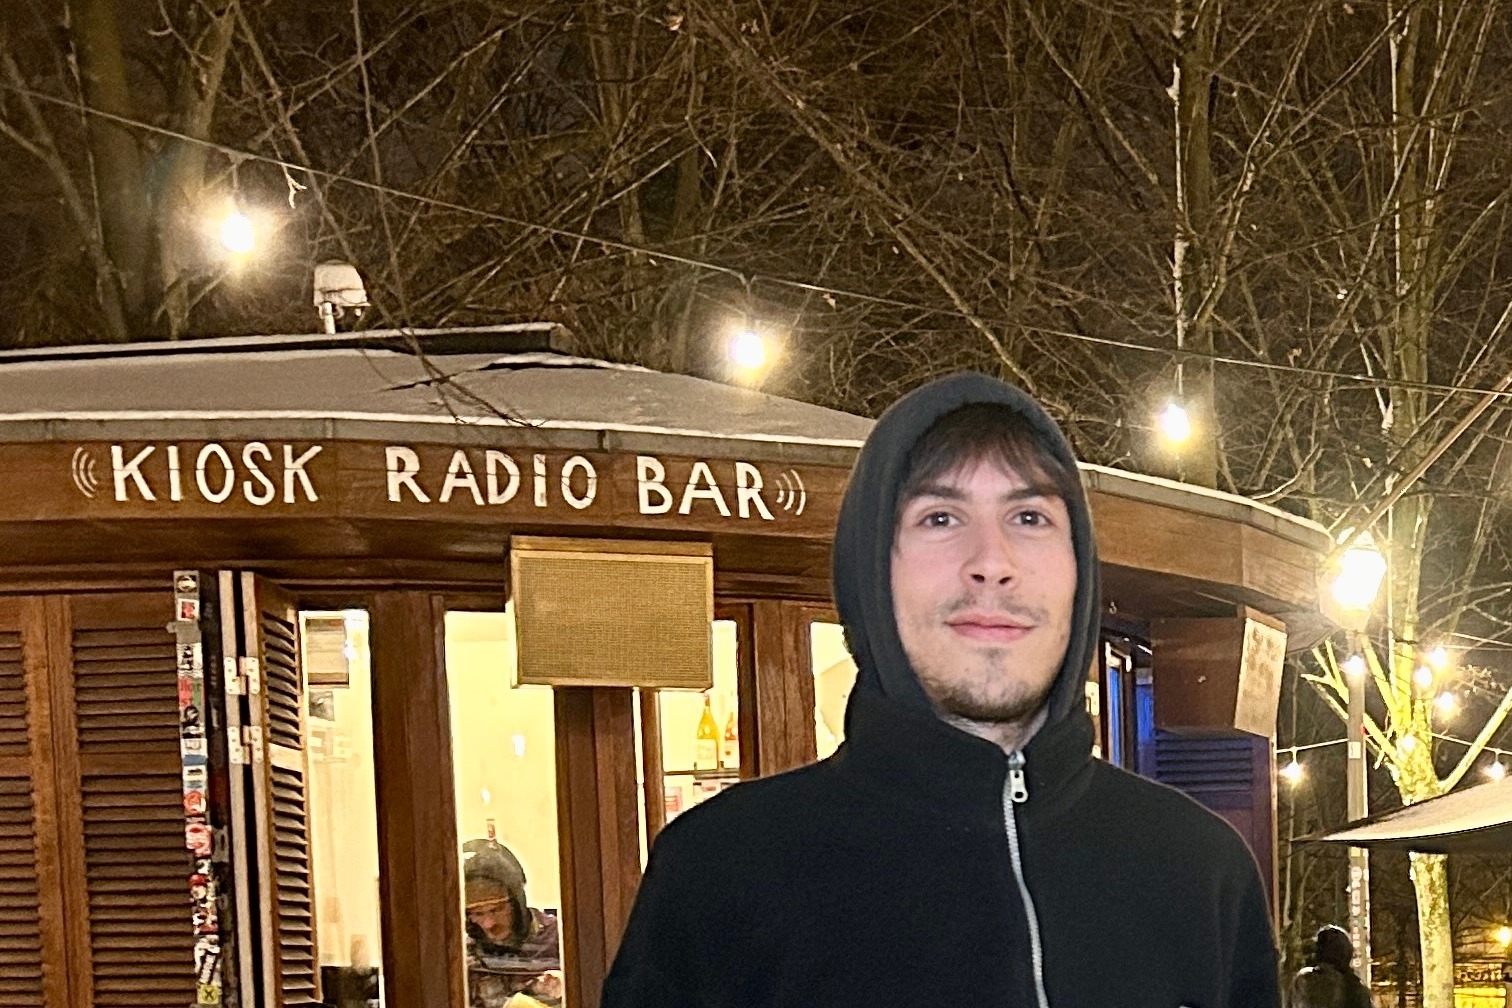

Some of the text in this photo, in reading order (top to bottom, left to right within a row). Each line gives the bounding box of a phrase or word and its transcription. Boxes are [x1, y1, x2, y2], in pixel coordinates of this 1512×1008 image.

[111, 441, 775, 520] KIOSK RADIO BAR
